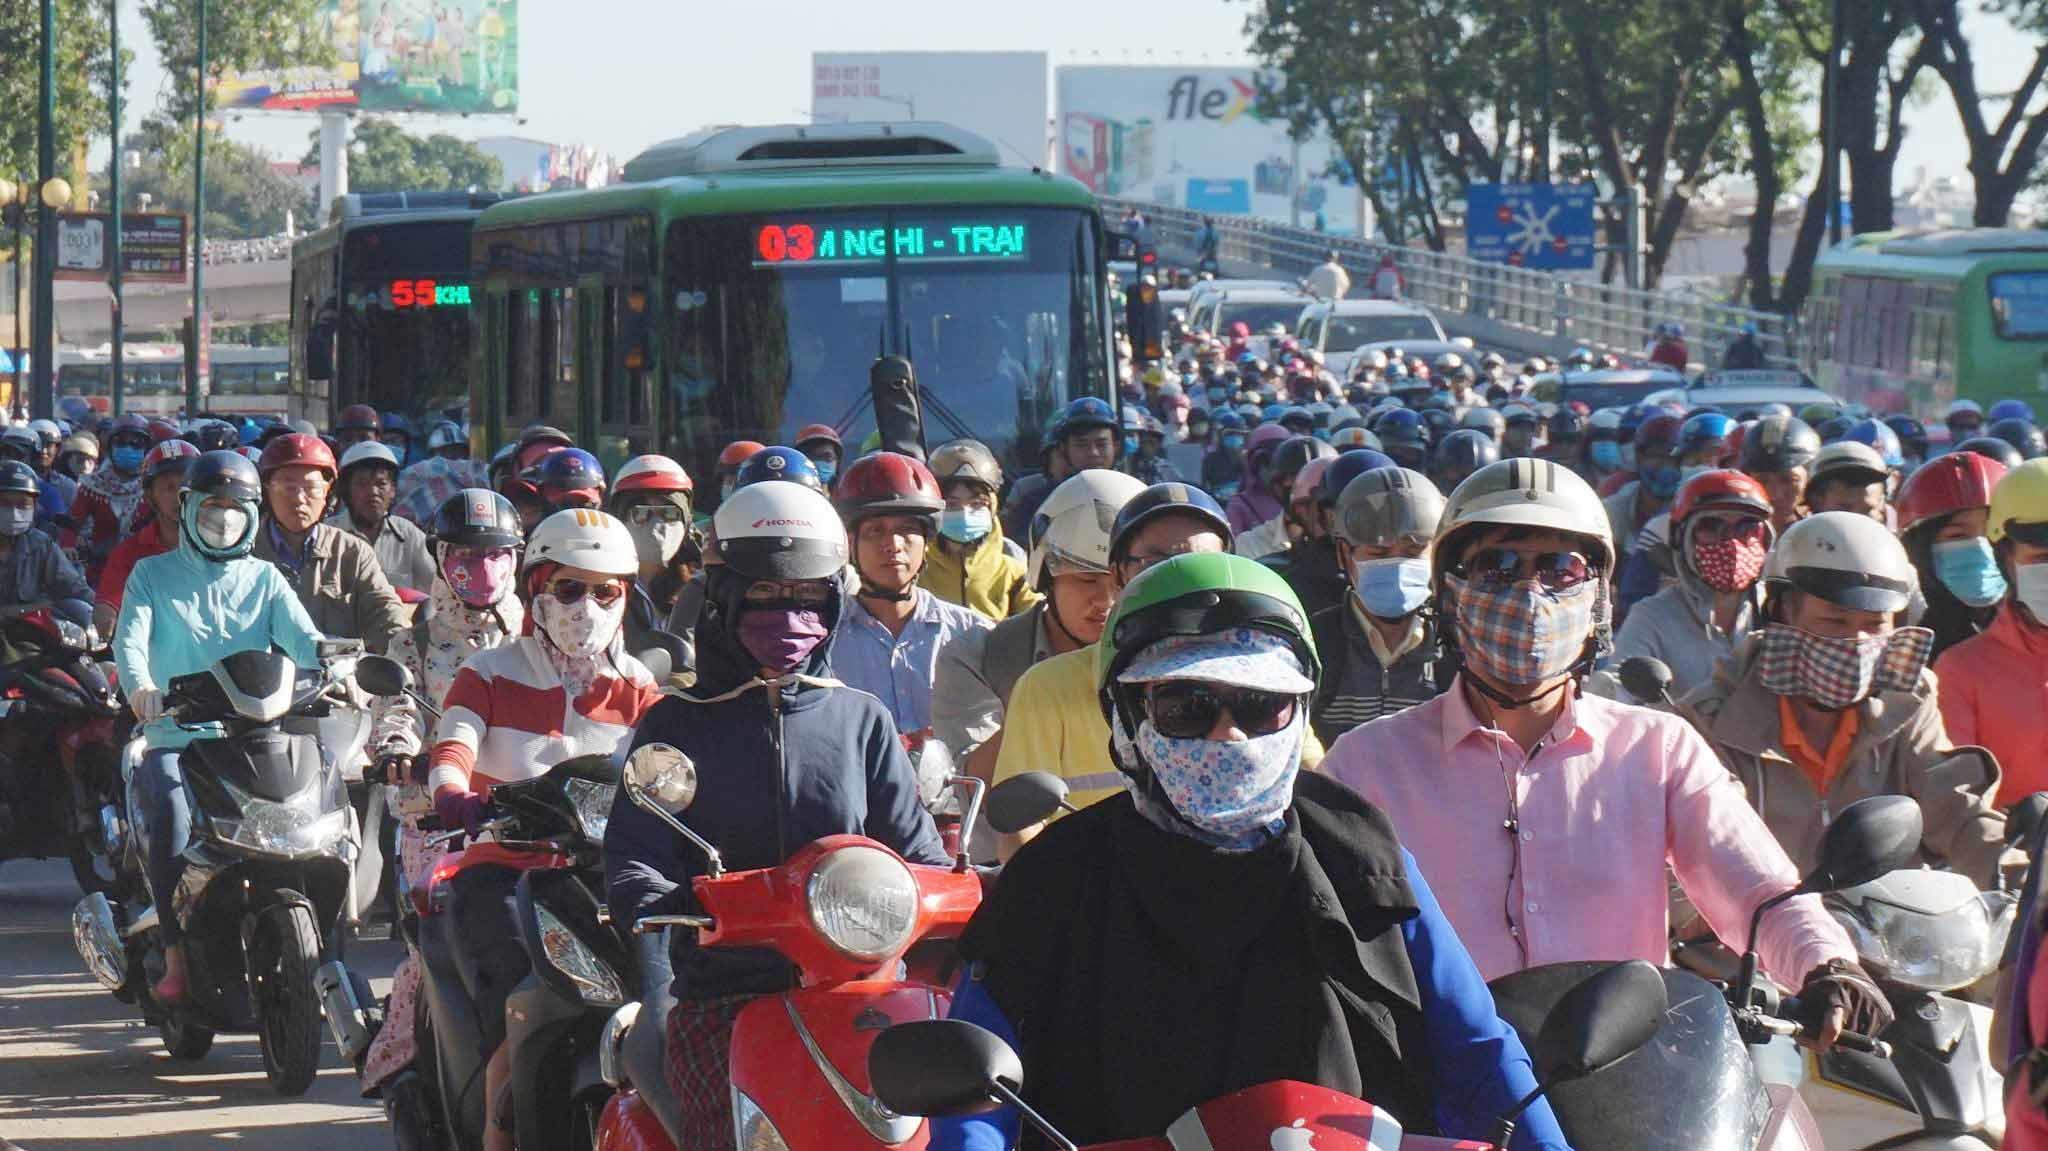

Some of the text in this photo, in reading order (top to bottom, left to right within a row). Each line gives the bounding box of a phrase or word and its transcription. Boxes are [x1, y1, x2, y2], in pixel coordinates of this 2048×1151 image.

[759, 225, 815, 261] 03
[391, 280, 435, 305] 55
[767, 519, 814, 529] HONDA
